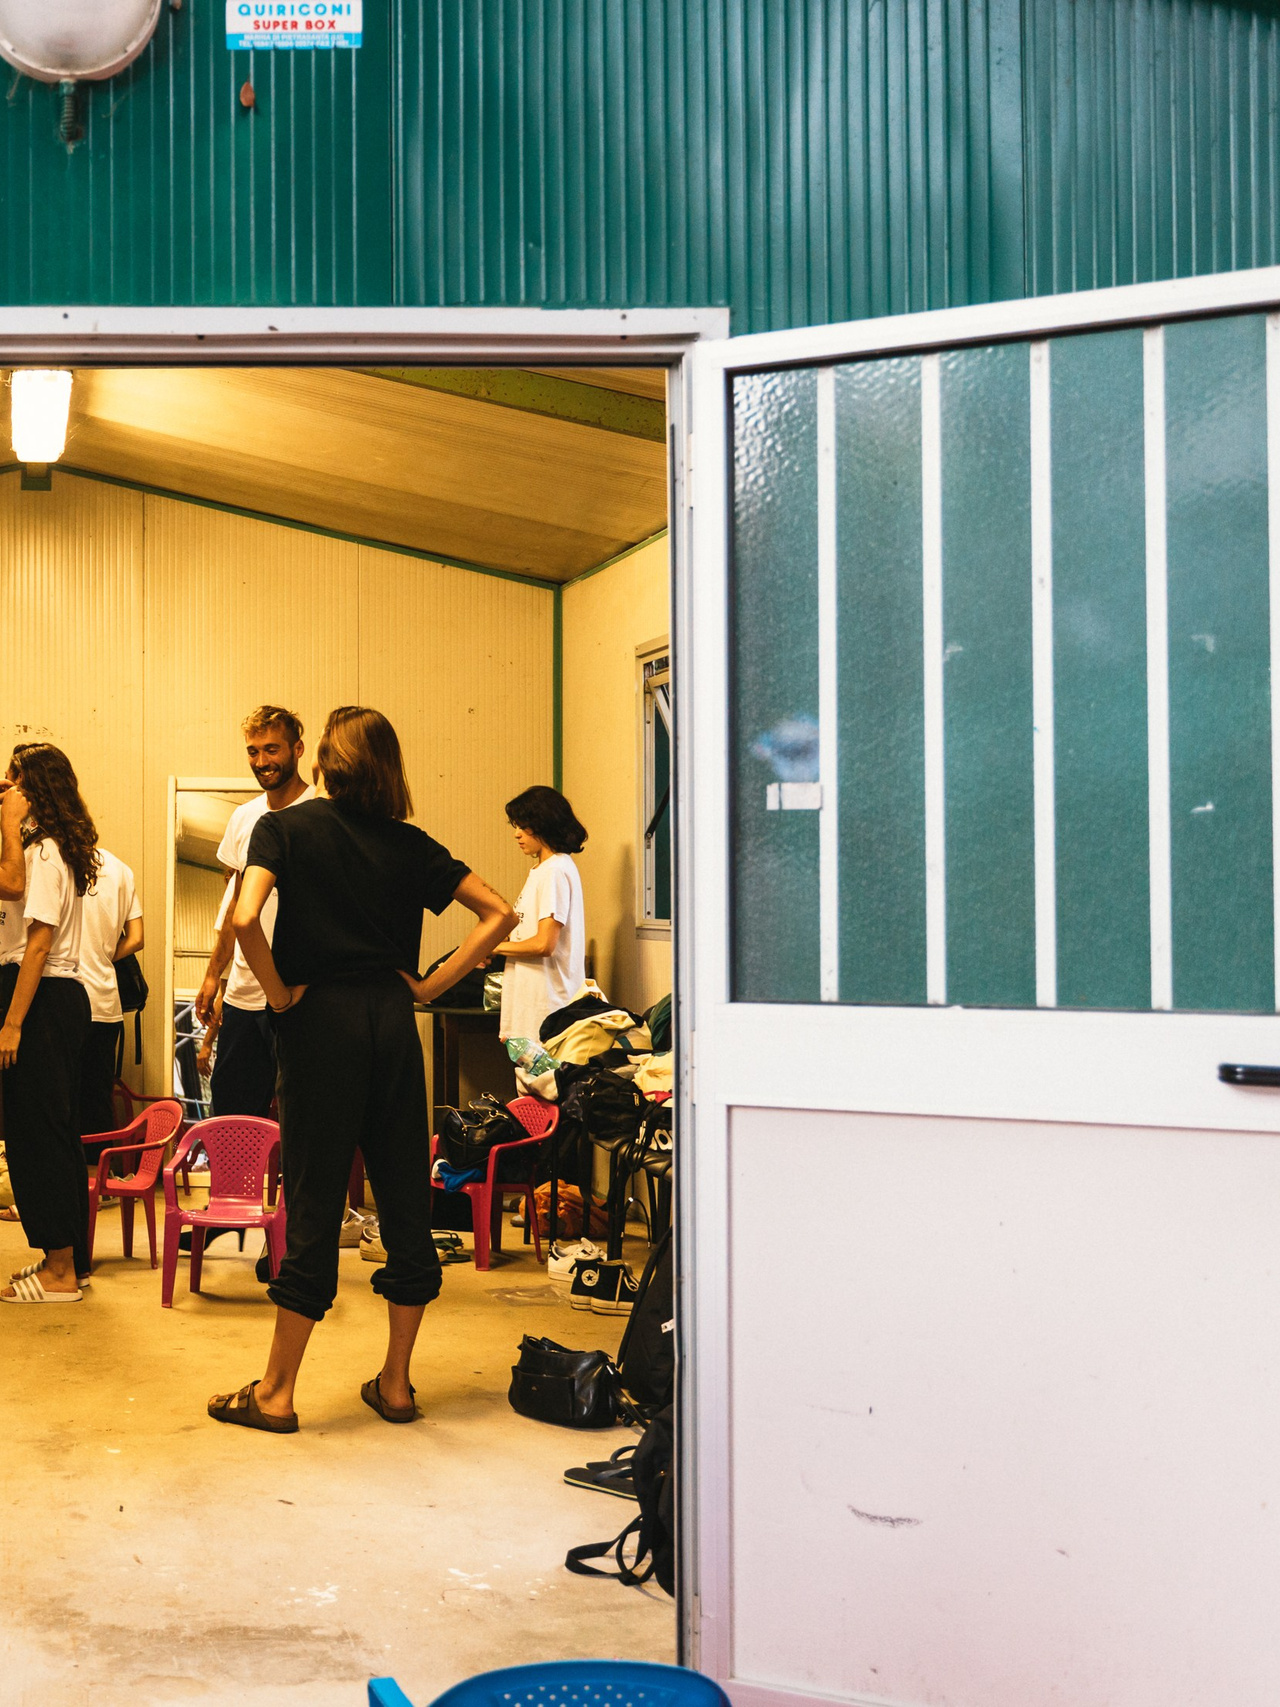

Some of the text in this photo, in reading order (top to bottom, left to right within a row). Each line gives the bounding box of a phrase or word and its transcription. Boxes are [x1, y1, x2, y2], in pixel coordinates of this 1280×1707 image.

[238, 3, 351, 16] QUIRICONI
[253, 19, 336, 30] SUPER BOX
